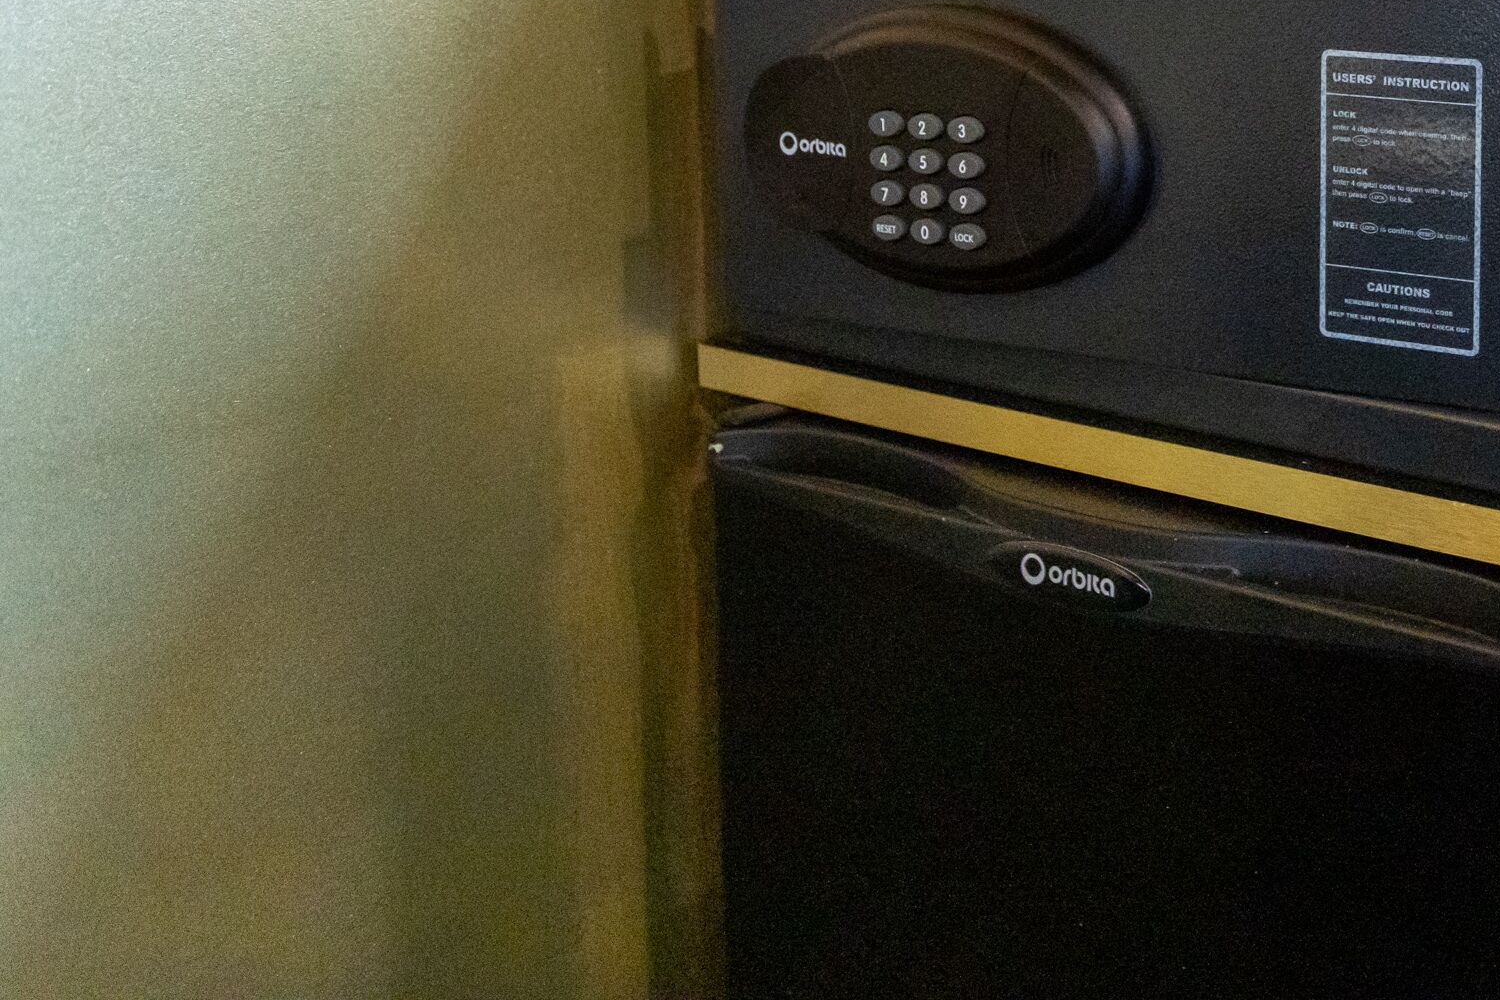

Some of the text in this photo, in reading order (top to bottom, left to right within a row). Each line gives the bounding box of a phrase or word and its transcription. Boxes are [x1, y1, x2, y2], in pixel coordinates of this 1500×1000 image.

[1383, 76, 1470, 91] INSTRUCTION
[1333, 110, 1356, 118] LOCK
[880, 118, 965, 138] 1 2 3
[1357, 126, 1378, 134] digital
[799, 138, 846, 158] orbita
[880, 152, 966, 173] 4 5 6
[1333, 166, 1368, 175] UNLOCK
[1356, 181, 1377, 189] digital
[881, 187, 967, 208] 7 8 9
[1349, 191, 1367, 199] press
[876, 224, 974, 243] RESET 0 LOCK
[1333, 221, 1358, 230] NOTE:
[1367, 282, 1430, 299] CAUTIONS
[1344, 298, 1379, 308] REMEMBER
[1400, 305, 1433, 315] PERSONAL
[1361, 314, 1376, 322] SAFE
[1378, 316, 1395, 324] OPEN
[1432, 323, 1454, 332] CHECK
[1049, 566, 1115, 598] orbita
